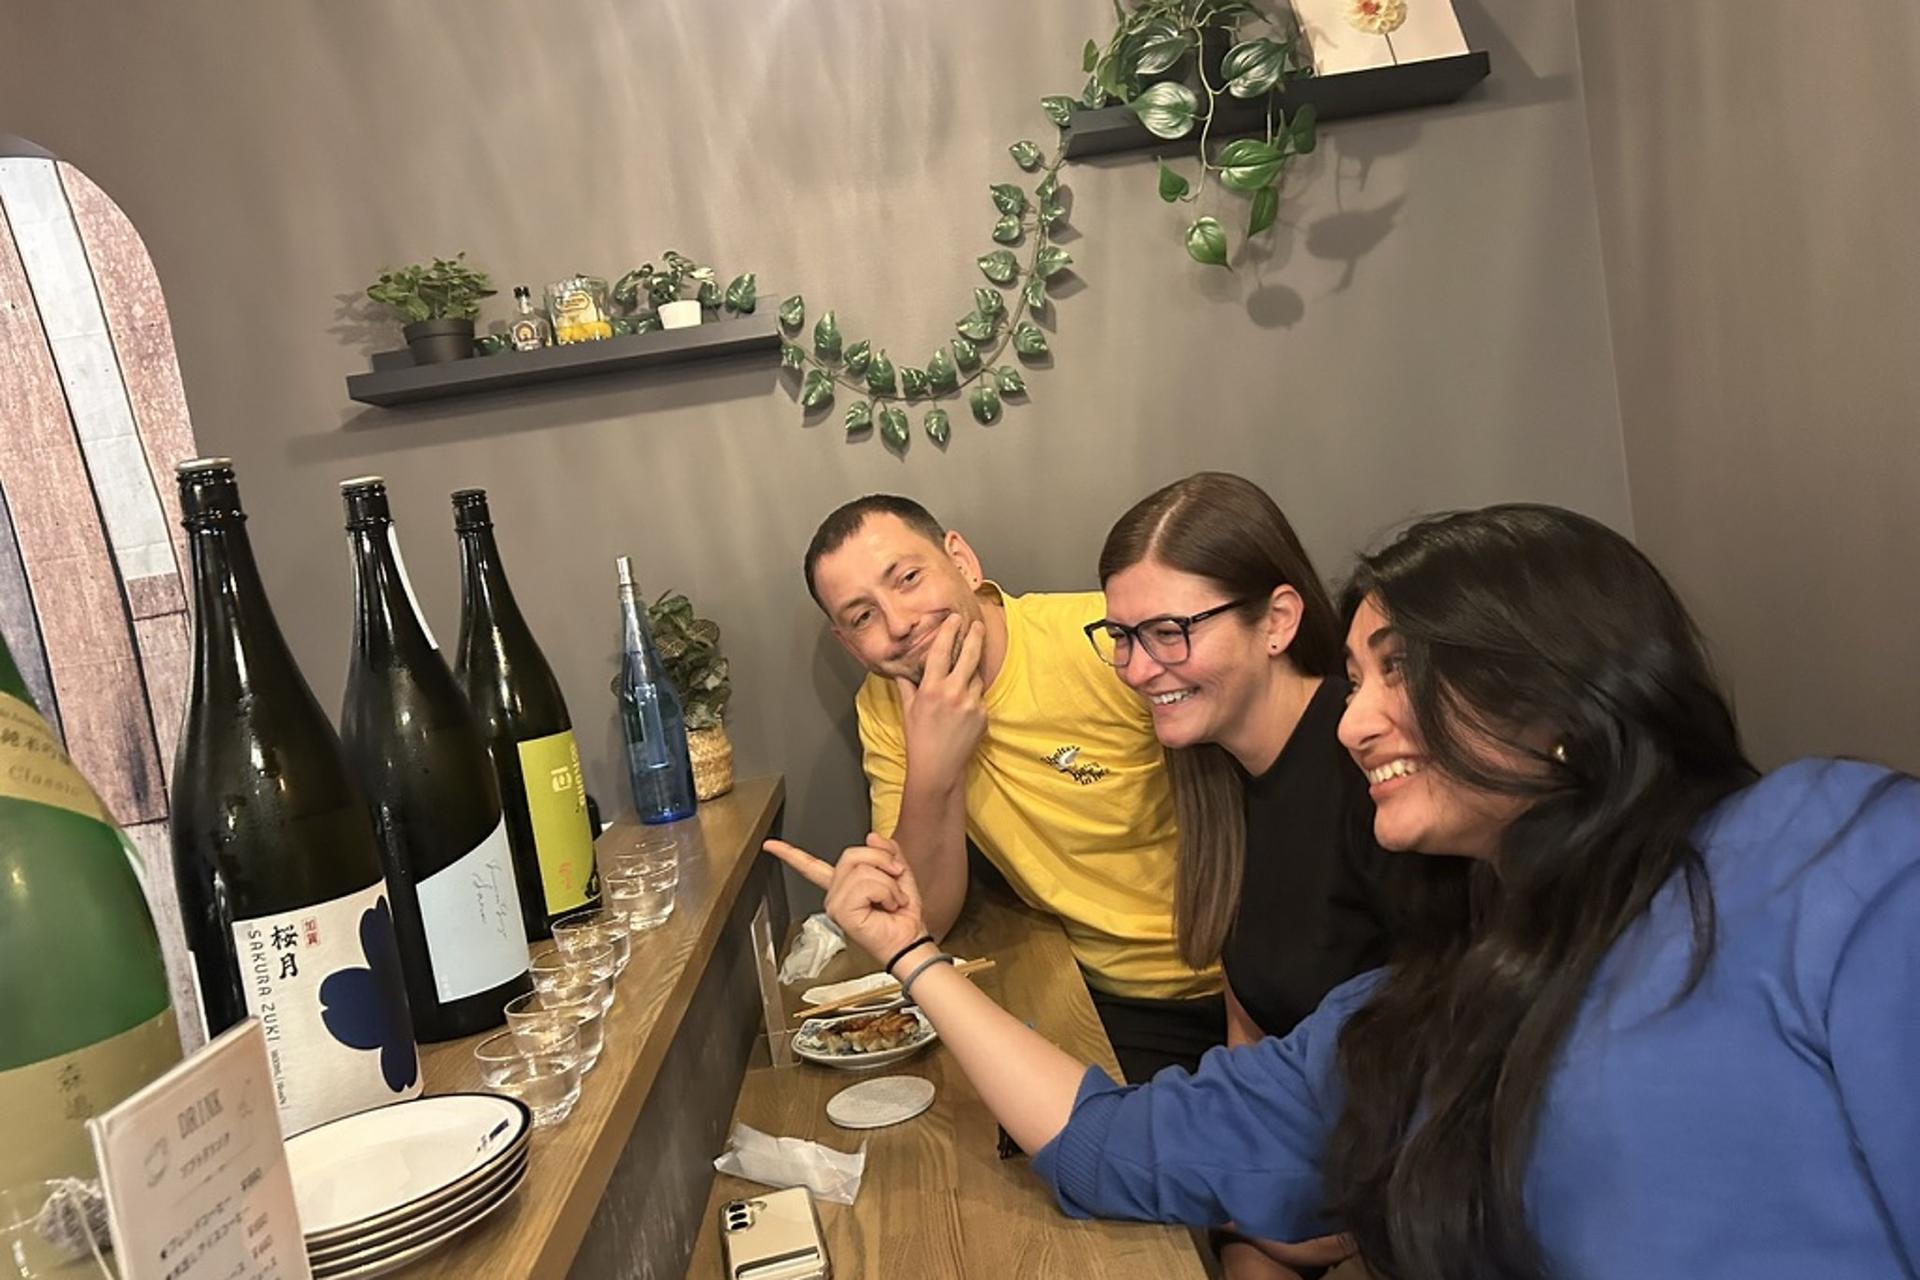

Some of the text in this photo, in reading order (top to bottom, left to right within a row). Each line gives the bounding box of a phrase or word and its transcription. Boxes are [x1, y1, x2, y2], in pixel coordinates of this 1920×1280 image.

[250, 929, 272, 997] SAKURA
[261, 1003, 281, 1042] ZUKI
[270, 924, 299, 980] 桜月
